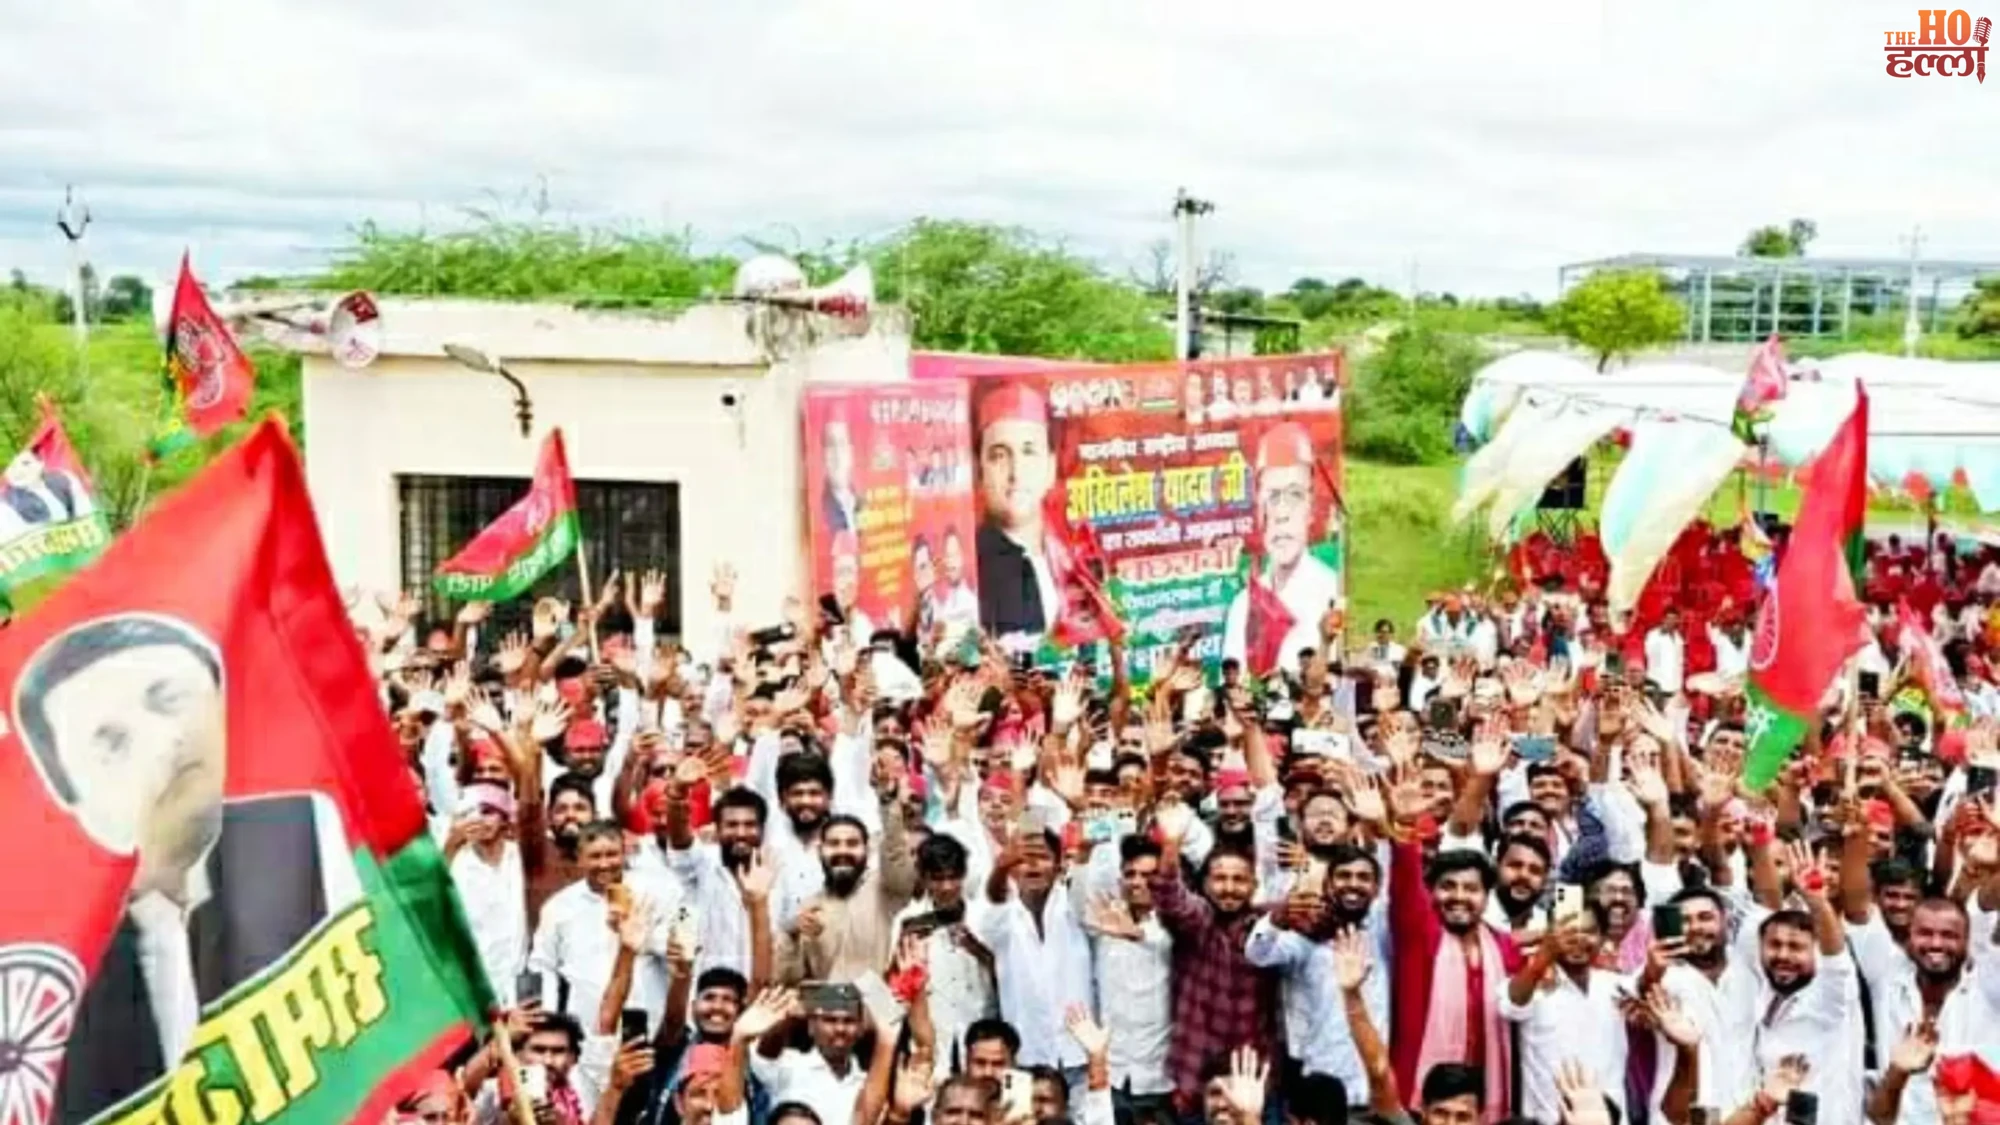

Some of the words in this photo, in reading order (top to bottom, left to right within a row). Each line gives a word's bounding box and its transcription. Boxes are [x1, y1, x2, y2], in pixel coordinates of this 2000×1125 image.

[1066, 461, 1155, 521] अखिलेश
[1164, 465, 1212, 509] यादव
[1221, 449, 1247, 501] जी
